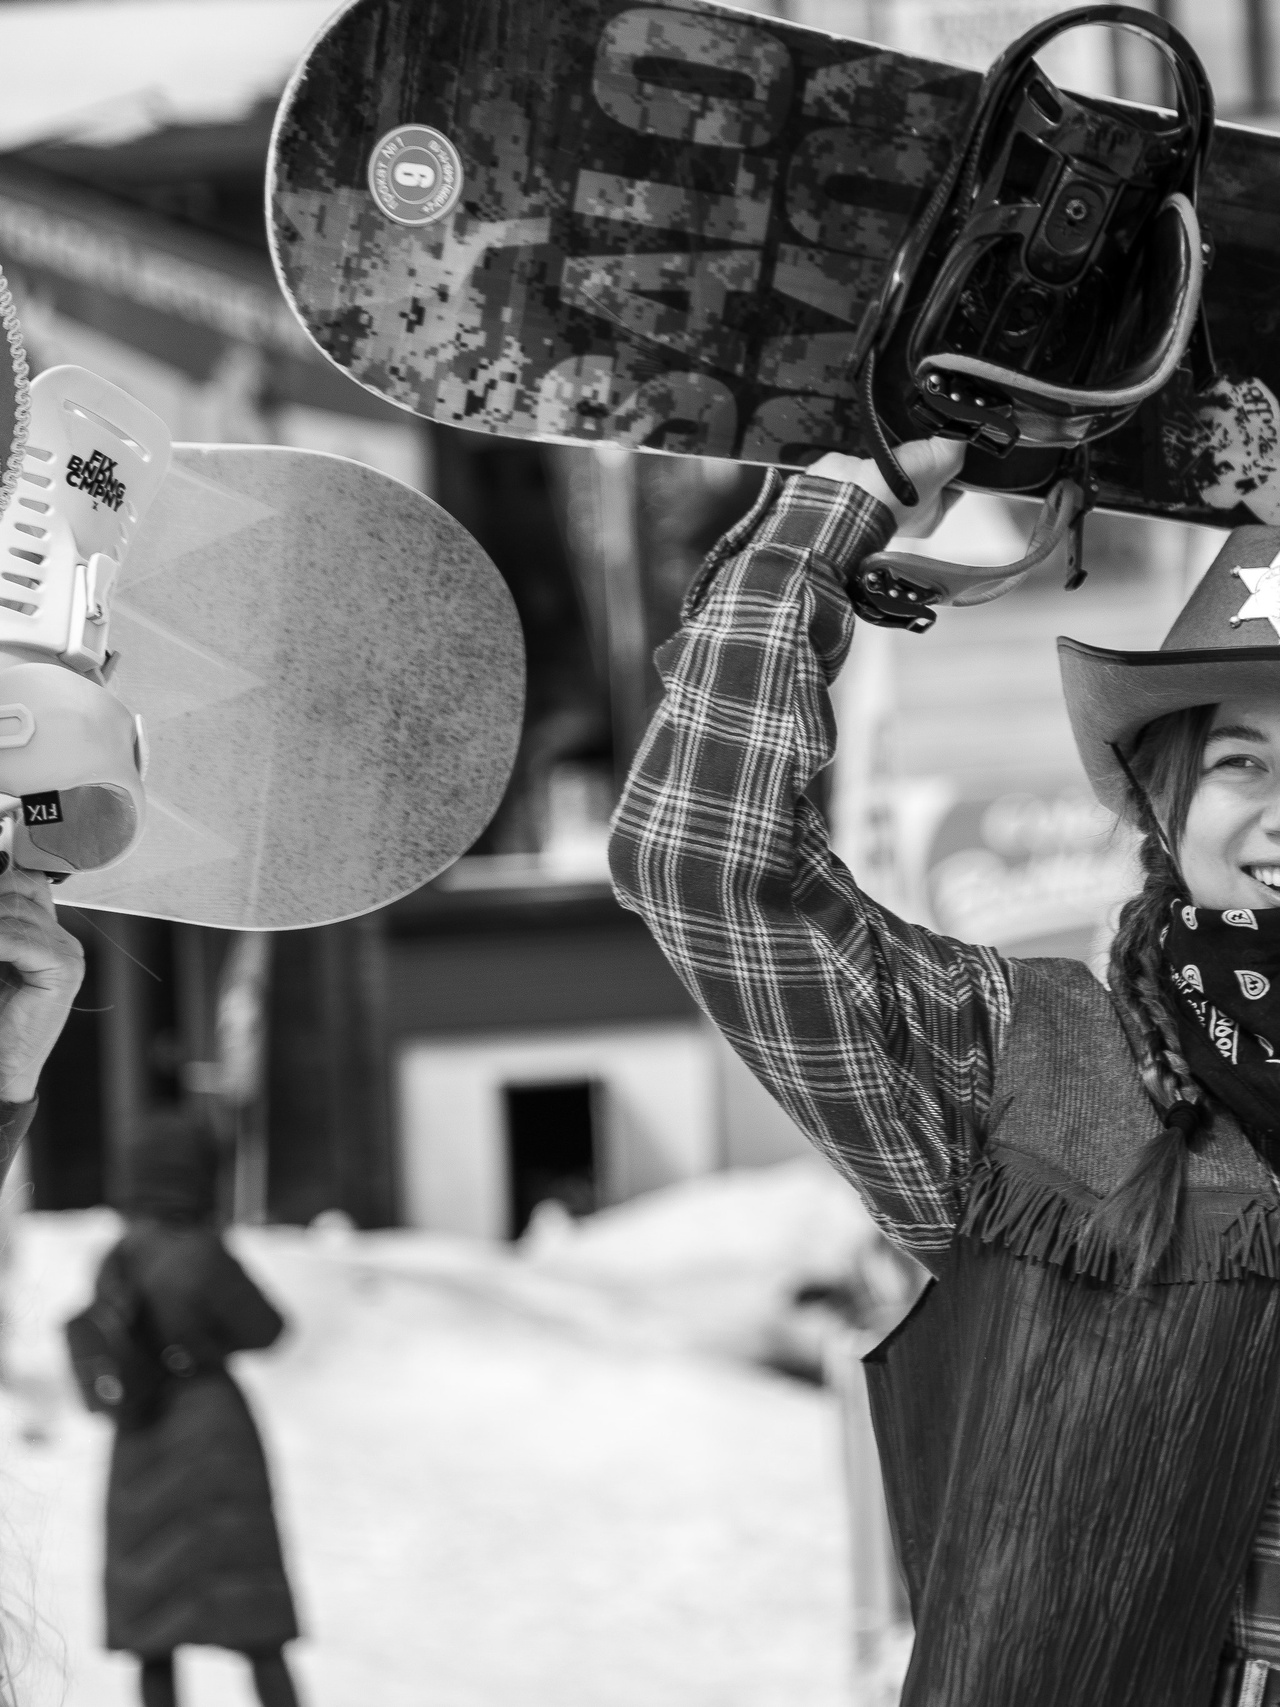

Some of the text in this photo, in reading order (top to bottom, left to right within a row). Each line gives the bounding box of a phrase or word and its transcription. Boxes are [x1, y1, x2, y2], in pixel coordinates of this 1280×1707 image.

[67, 455, 126, 499] BNDNG
[89, 449, 119, 476] FIX
[66, 471, 124, 512] CMPNY
[27, 803, 58, 821] FIX
